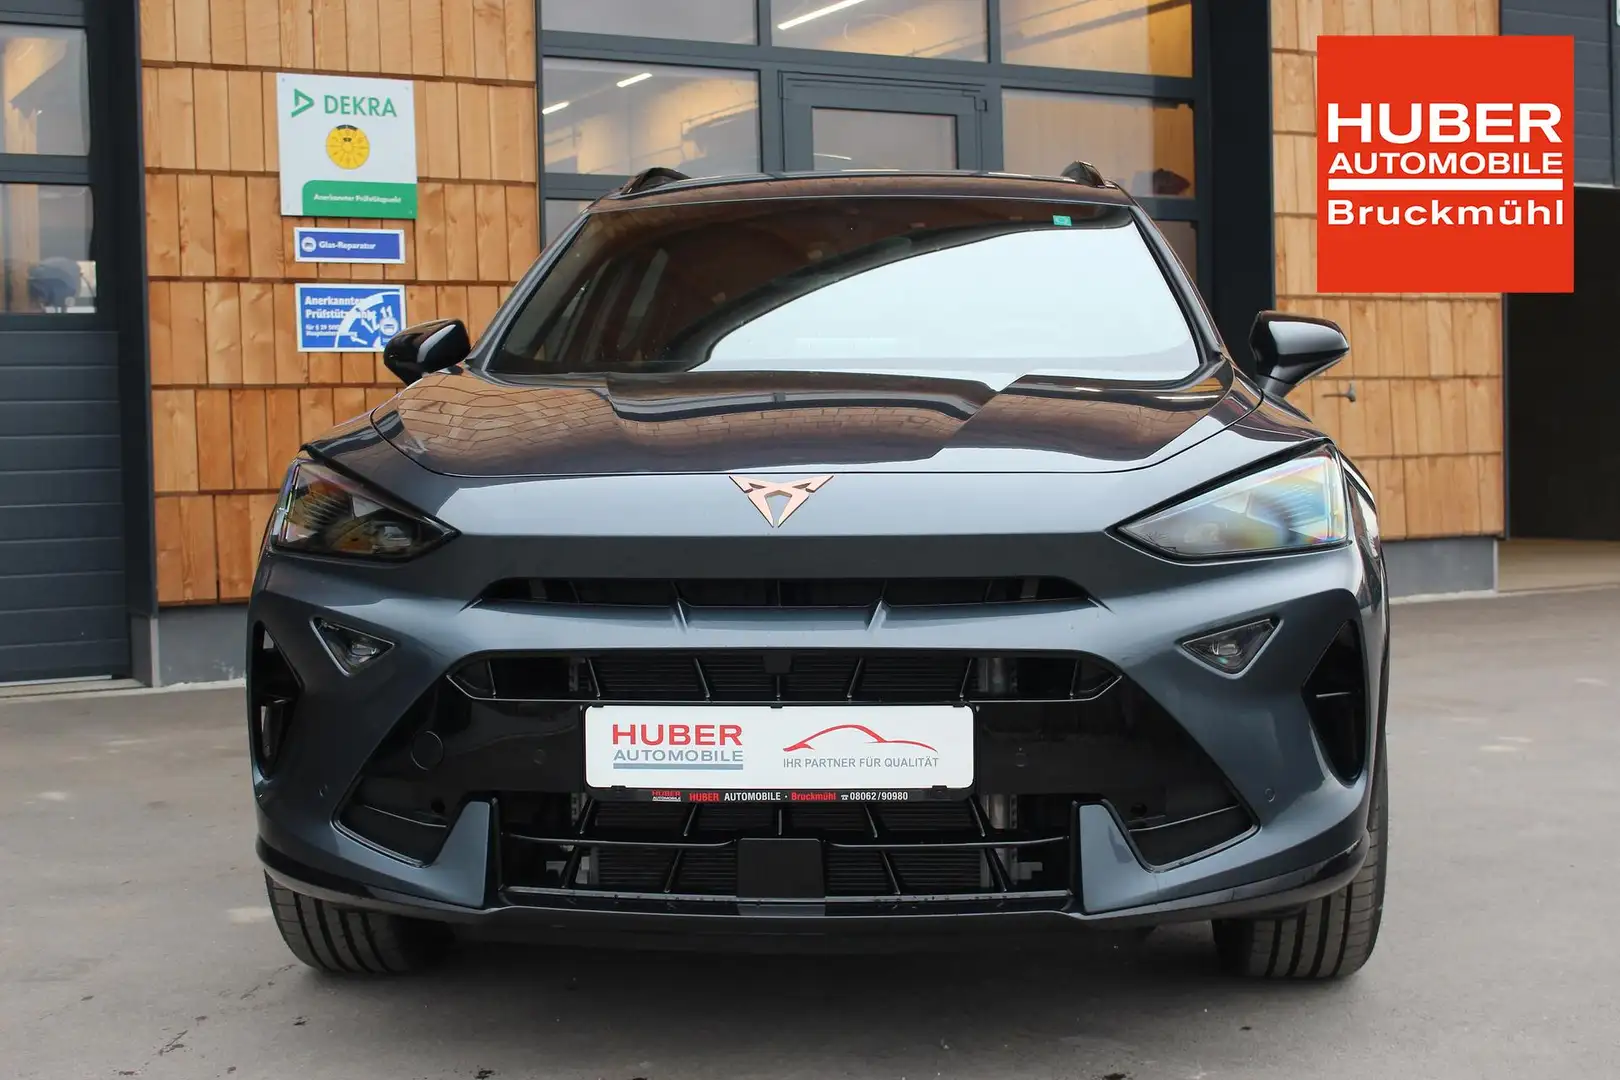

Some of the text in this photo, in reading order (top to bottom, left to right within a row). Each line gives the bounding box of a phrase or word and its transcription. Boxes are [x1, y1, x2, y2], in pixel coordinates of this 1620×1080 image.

[323, 94, 398, 117] DEKRA
[318, 240, 377, 251] Glas-Reparatur
[612, 723, 743, 746] HUBER
[613, 749, 744, 762] AUTOMOBILE
[783, 757, 939, 768] IHR PARTNER FÜR QUALITÄT
[689, 792, 719, 802] HUBER
[724, 792, 781, 801] AUTOMOBILE
[791, 792, 837, 801] Bruckmühl
